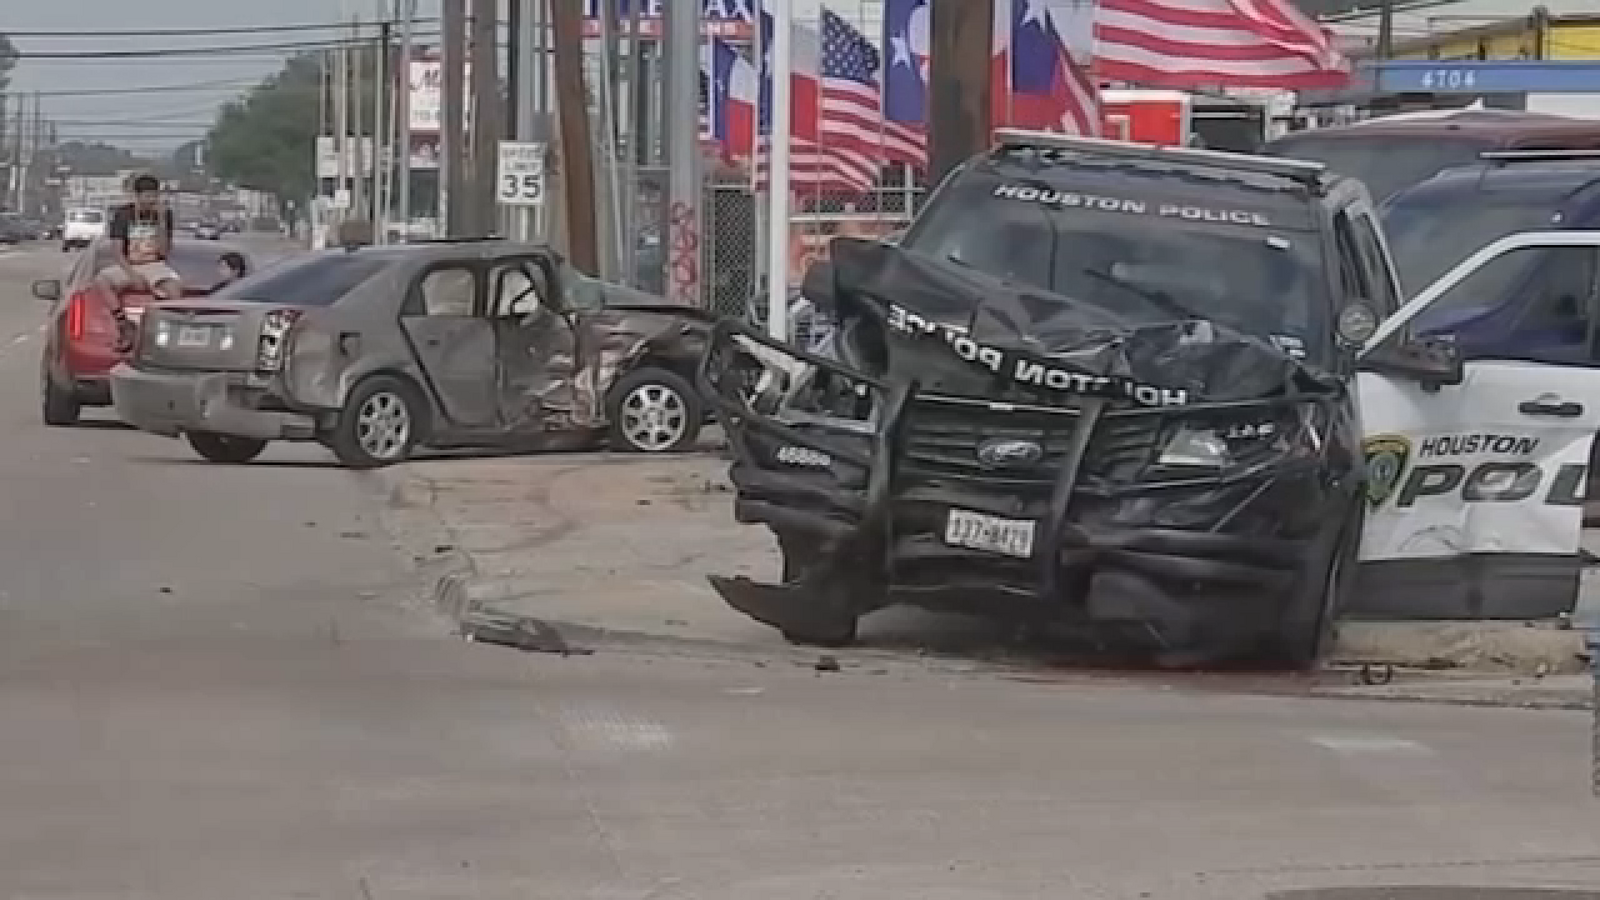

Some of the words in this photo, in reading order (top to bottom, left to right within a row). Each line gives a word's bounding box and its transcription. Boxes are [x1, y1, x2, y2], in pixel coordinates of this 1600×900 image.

[502, 175, 541, 198] 35
[993, 184, 1147, 214] HOUSTON
[1419, 434, 1540, 458] HOUSTON
